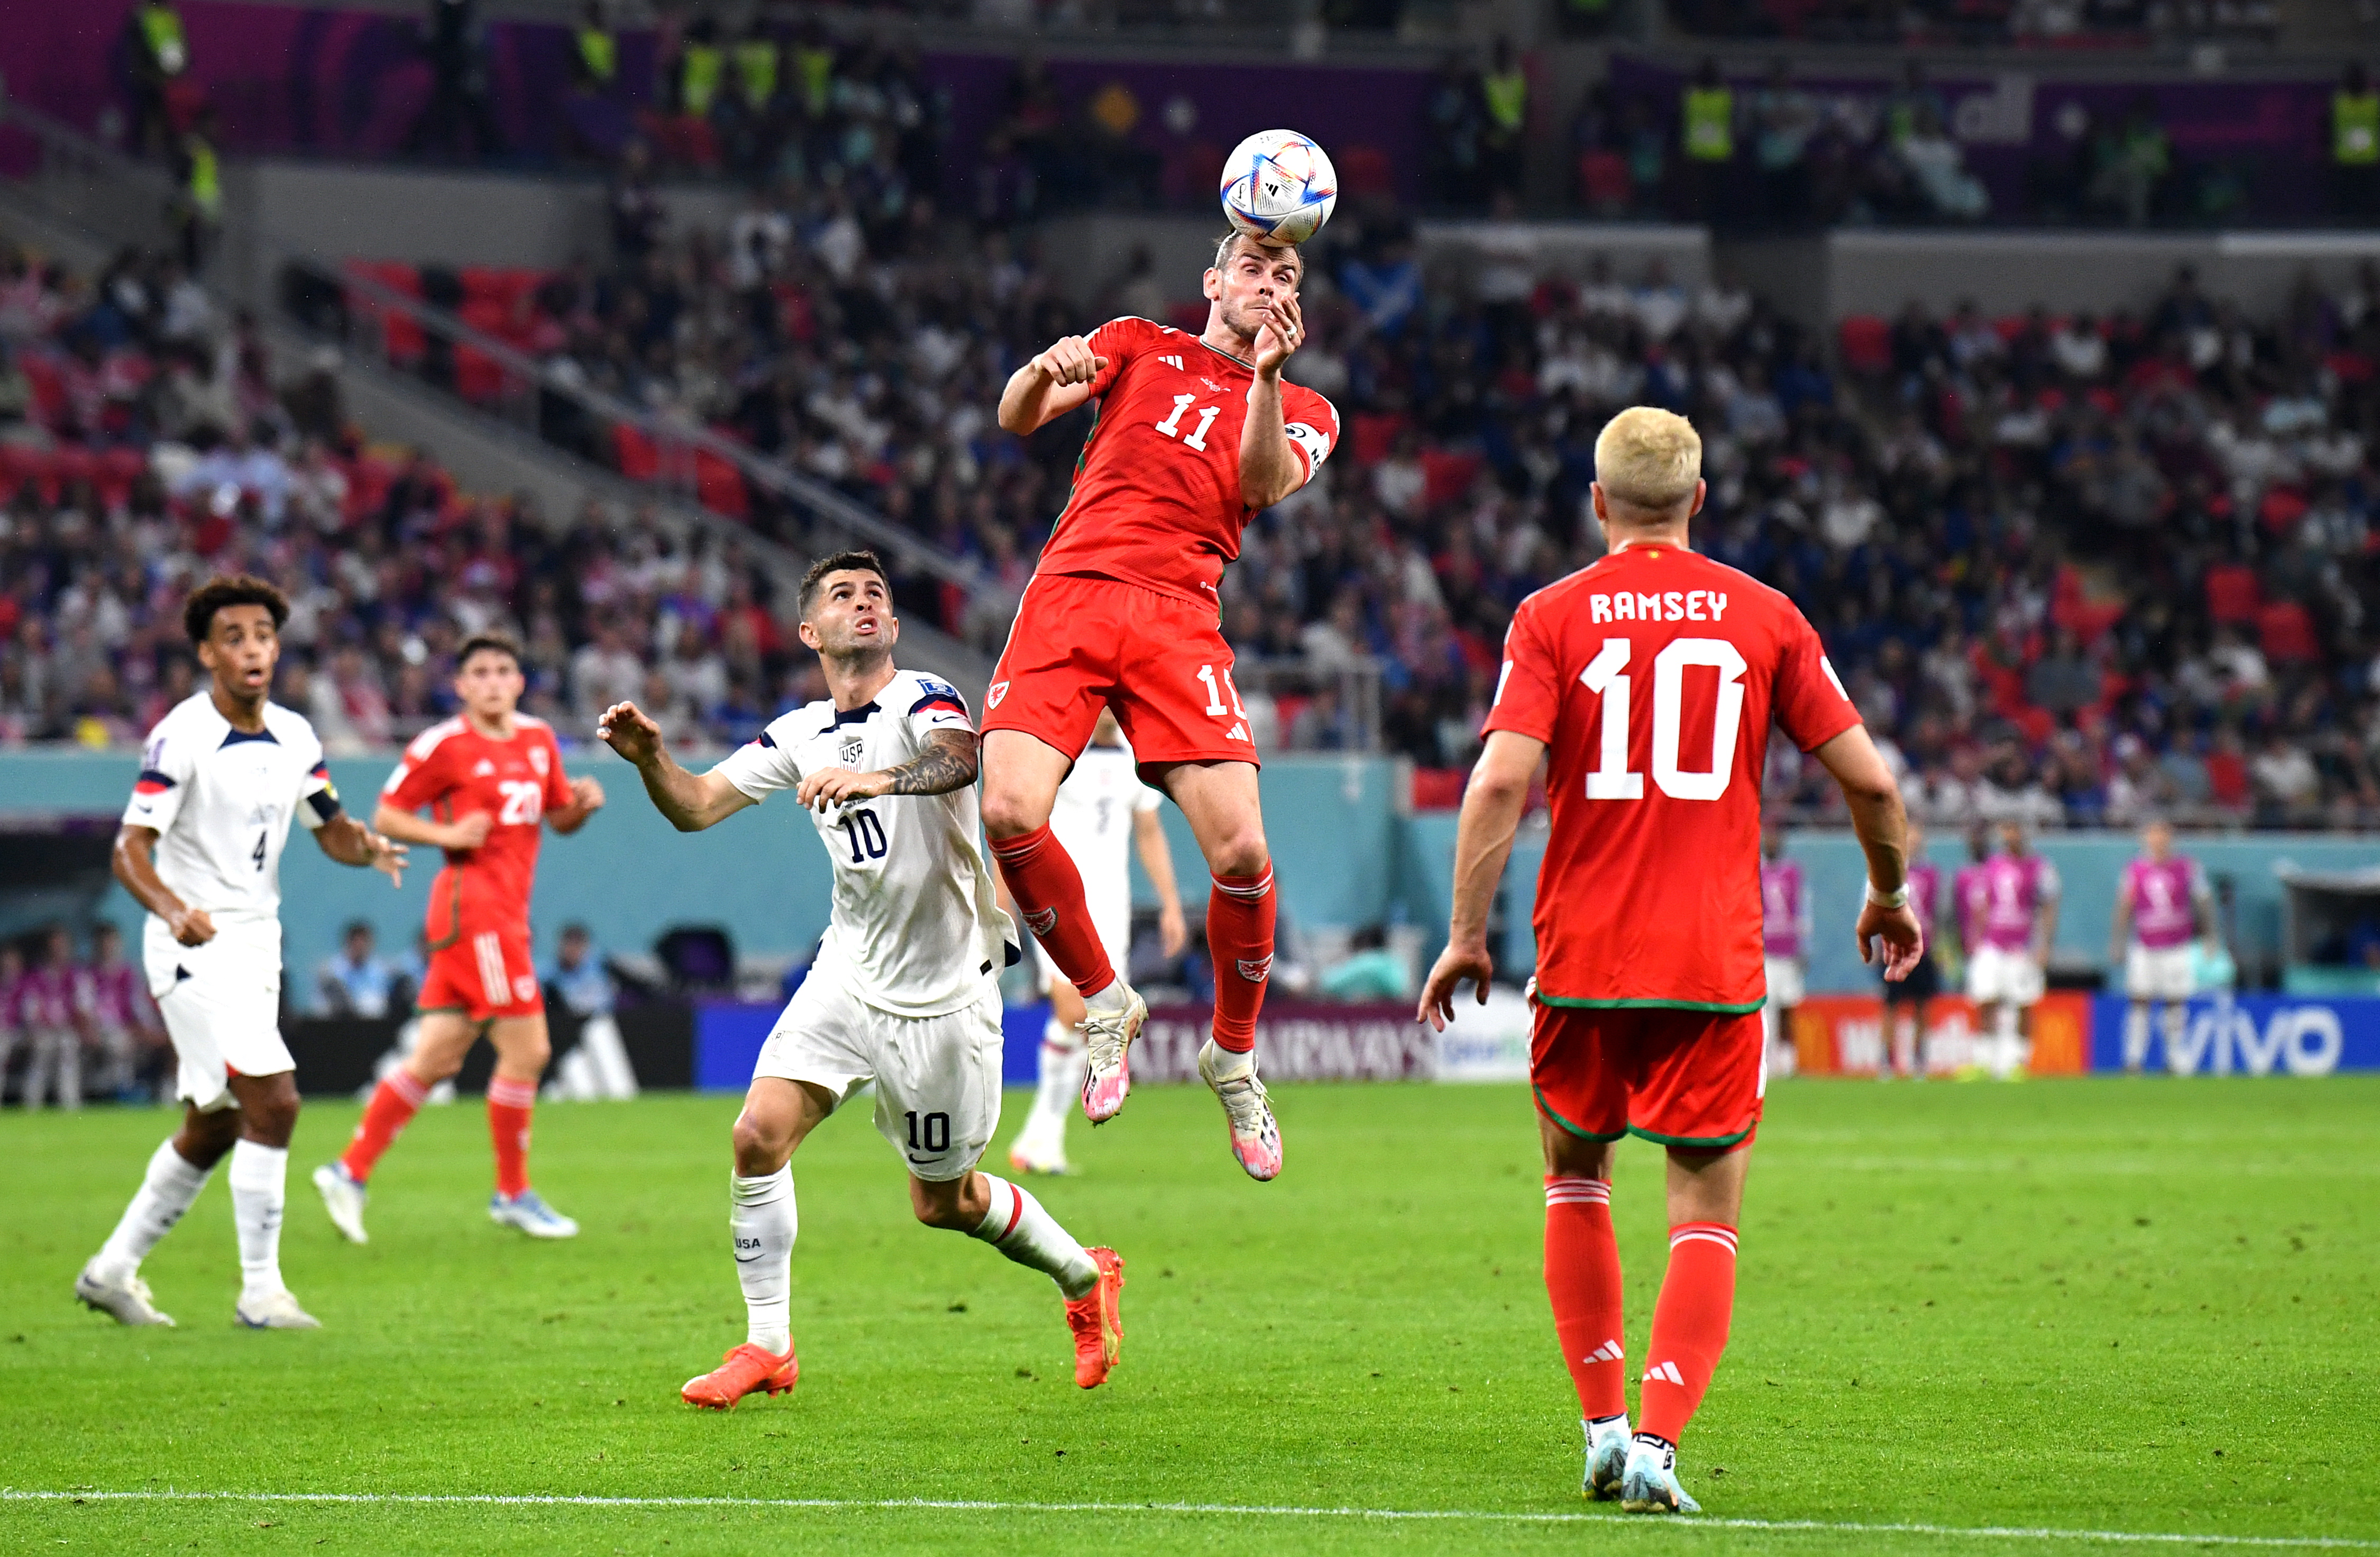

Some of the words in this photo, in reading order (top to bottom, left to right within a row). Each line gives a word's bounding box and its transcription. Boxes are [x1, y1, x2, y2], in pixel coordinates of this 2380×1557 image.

[1155, 393, 1221, 452] 11
[1590, 590, 1727, 624] RAMSEY
[1580, 638, 1747, 801] 10
[842, 743, 863, 763] USA
[498, 780, 542, 825] 20
[252, 831, 267, 872] 4
[839, 808, 887, 863] 10
[905, 1112, 950, 1152] 10
[735, 1238, 761, 1249] USA
